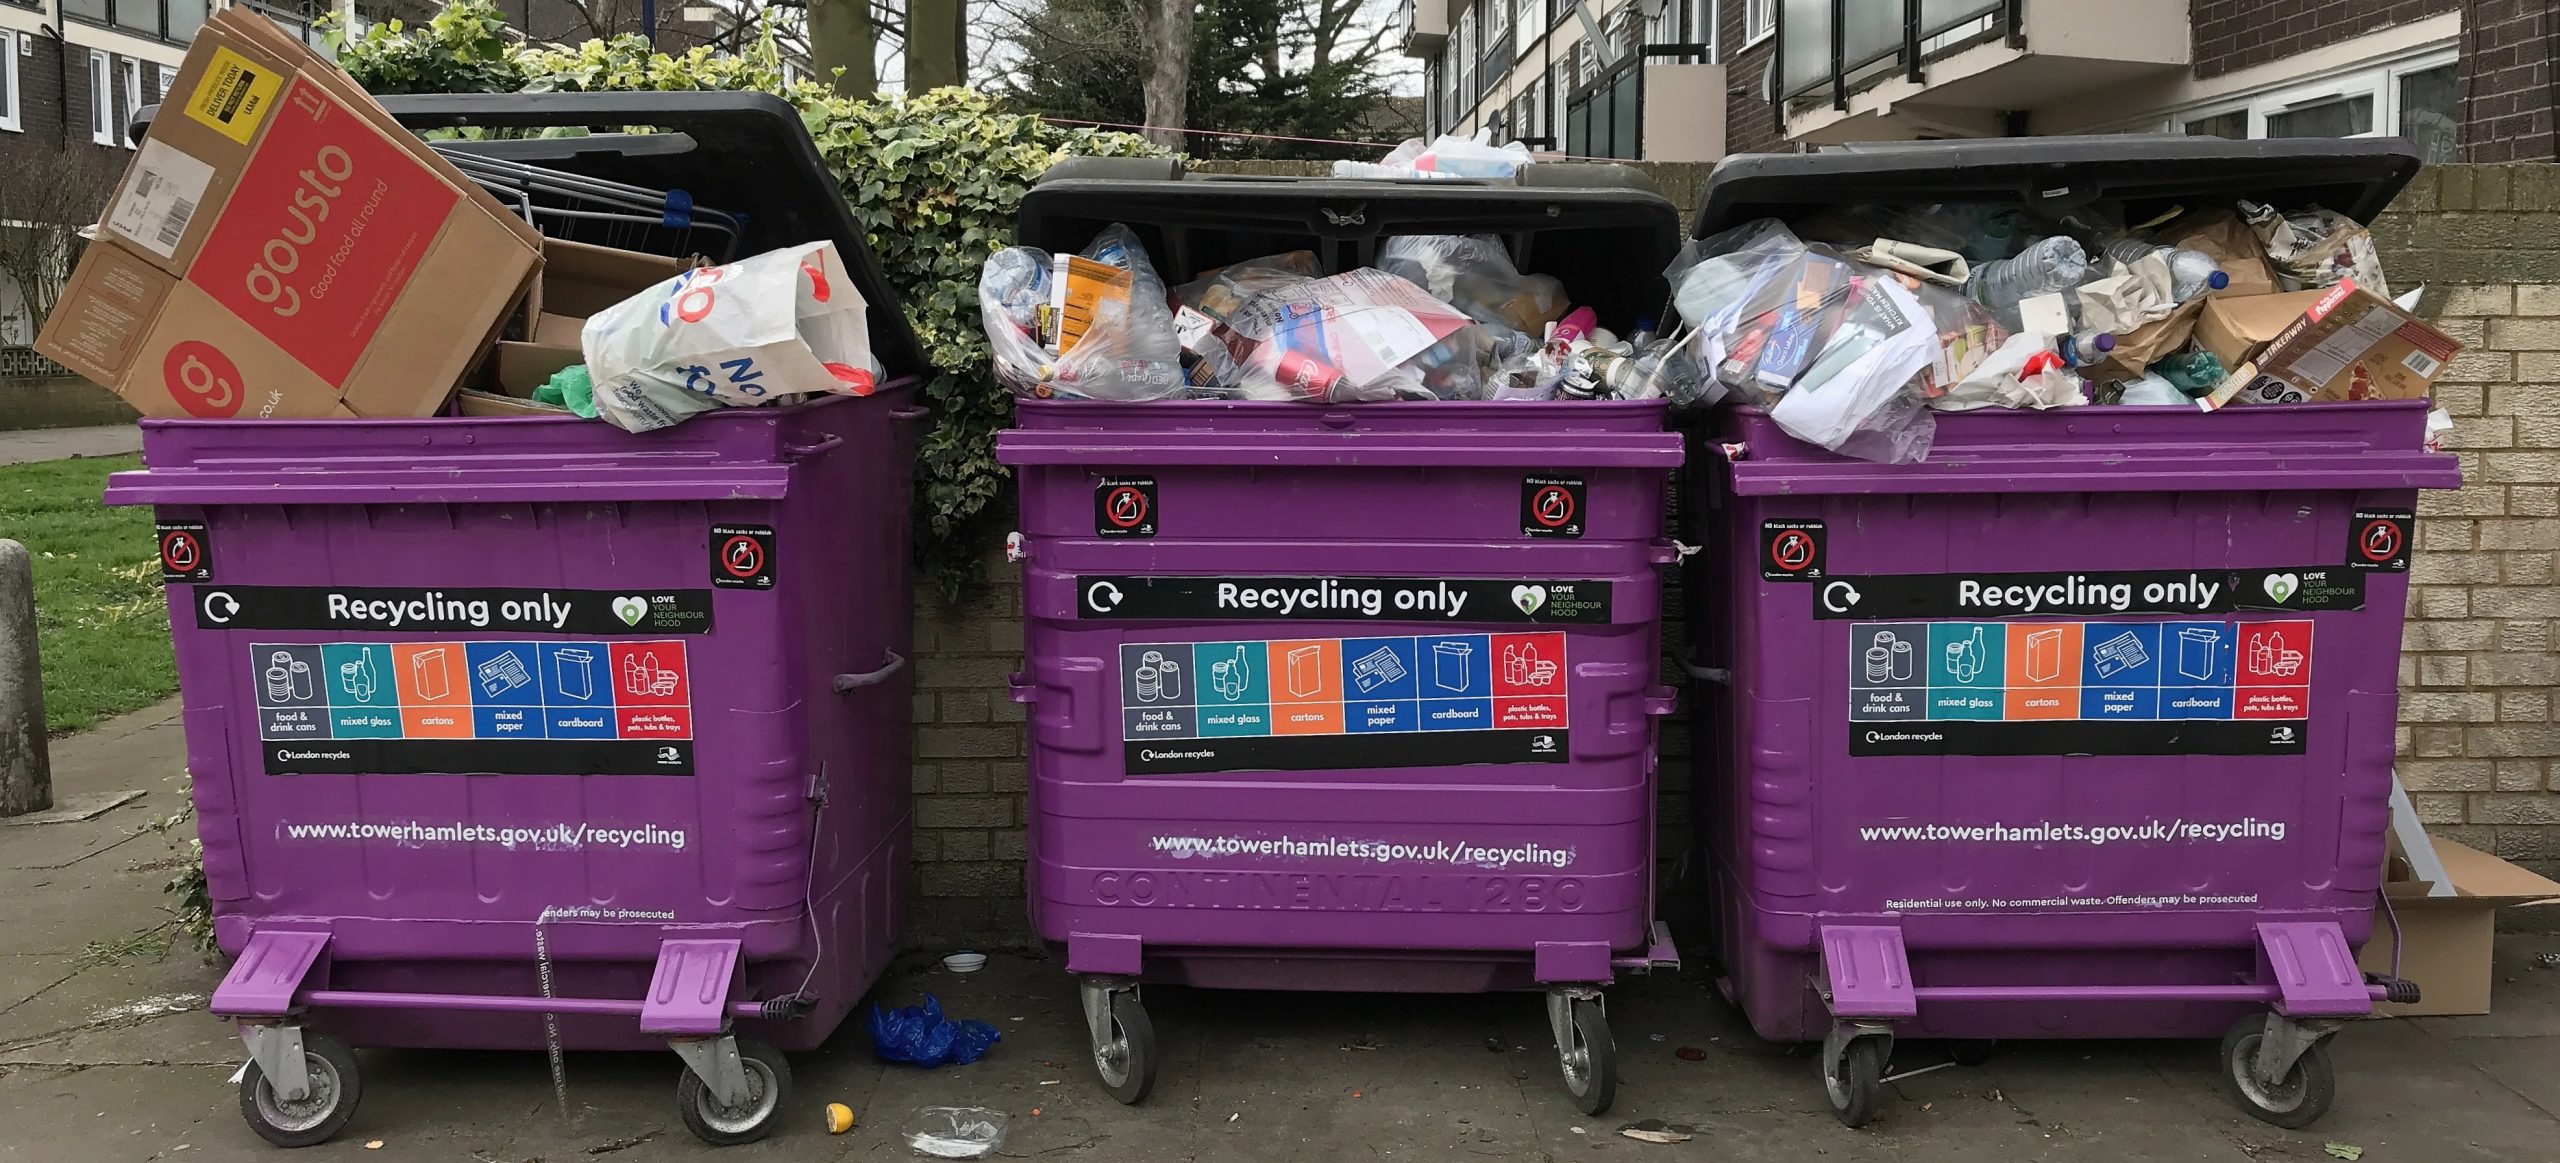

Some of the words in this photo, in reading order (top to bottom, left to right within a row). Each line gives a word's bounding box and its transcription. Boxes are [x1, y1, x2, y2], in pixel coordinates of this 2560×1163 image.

[206, 86, 229, 116] DELIVER
[225, 64, 240, 88] TODAY
[246, 145, 353, 317] gousto
[309, 264, 338, 300] Good
[327, 233, 357, 267] food
[351, 217, 367, 237] all
[360, 177, 389, 219] round
[1864, 293, 1877, 307] YOU
[1873, 304, 1881, 313] IS
[1879, 299, 1904, 327] KITCHEN
[1879, 312, 1896, 331] WHAT
[2266, 318, 2307, 356] TAKEAWAY
[630, 380, 642, 395] We
[2303, 572, 2326, 580] LOVE
[1550, 585, 1575, 593] LOVE
[2303, 580, 2328, 588] YOUR
[1550, 593, 1575, 602] YOUR
[1959, 575, 2131, 612] Recycling
[2143, 573, 2220, 610] only
[2302, 588, 2355, 597] NEIGHBOUR
[652, 595, 677, 604] LOVE
[1218, 580, 1381, 615] Recycling
[1394, 581, 1468, 617] only
[2302, 596, 2329, 604] HOOD
[327, 591, 490, 627] Recycling
[501, 592, 572, 629] only
[652, 604, 677, 612] YOUR
[1550, 602, 1602, 610] NEIGHBOUR
[653, 611, 705, 620] NEIGHBOUR
[1550, 609, 1578, 617] HOOD
[654, 619, 681, 628] HOOD
[1870, 692, 1893, 703] food
[1894, 692, 1903, 702] &
[2104, 690, 2135, 701] mixed
[2248, 695, 2270, 704] plastic
[2271, 694, 2294, 703] bottles,
[1507, 704, 1528, 713] plastic
[1528, 703, 1552, 712] bottles,
[1862, 702, 1888, 713] drink
[1888, 705, 1911, 713] cans
[1937, 696, 1967, 707] mixed
[1968, 697, 1994, 709] glass
[2025, 698, 2060, 707] cartons
[2171, 697, 2221, 708] cardboard
[2275, 703, 2282, 711] &
[1367, 704, 1396, 715] mixed
[1431, 707, 1479, 719] cardboard
[2104, 704, 2134, 714] paper
[275, 711, 298, 722] food
[299, 711, 308, 721] &
[495, 710, 523, 720] mixed
[631, 714, 652, 724] plastic
[652, 714, 676, 722] bottles,
[1141, 711, 1165, 722] food
[1166, 711, 1174, 721] &
[1207, 714, 1235, 725] mixed
[1237, 713, 1261, 726] glass
[1290, 713, 1325, 722] cartons
[1534, 712, 1541, 720] &
[270, 720, 295, 732] drink
[296, 724, 317, 732] cans
[340, 715, 369, 726] mixed
[370, 715, 392, 727] glass
[421, 716, 454, 726] cartons
[557, 716, 604, 728] cardboard
[1135, 721, 1159, 732] drink
[1160, 723, 1182, 731] cans
[1367, 715, 1396, 727] paper
[496, 723, 524, 733] paper
[1880, 731, 1911, 741] London
[1911, 731, 1943, 742] recycles
[291, 750, 321, 759] London
[321, 750, 351, 761] recycles
[1154, 749, 1184, 759] London
[1184, 748, 1215, 760] recycles
[287, 820, 685, 851] www.towerhamlets.gov.uk/recycling
[1860, 818, 2286, 844] www.towerhamlets.gov.uk/recycling
[1152, 834, 1568, 868] www.towerhamlets.gov.uk/recycling
[1092, 869, 1443, 911] CONTINENTAL
[1469, 875, 1587, 914] 1280
[1887, 899, 1941, 908] Residential
[1965, 898, 1988, 909] only.
[2010, 896, 2067, 906] commercial
[2106, 895, 2157, 905] Offenders
[2158, 896, 2182, 907] may
[2183, 894, 2197, 904] be
[2199, 893, 2258, 906] prosecuted
[580, 910, 601, 919] may
[603, 908, 616, 917] be
[618, 909, 676, 919] prosecuted
